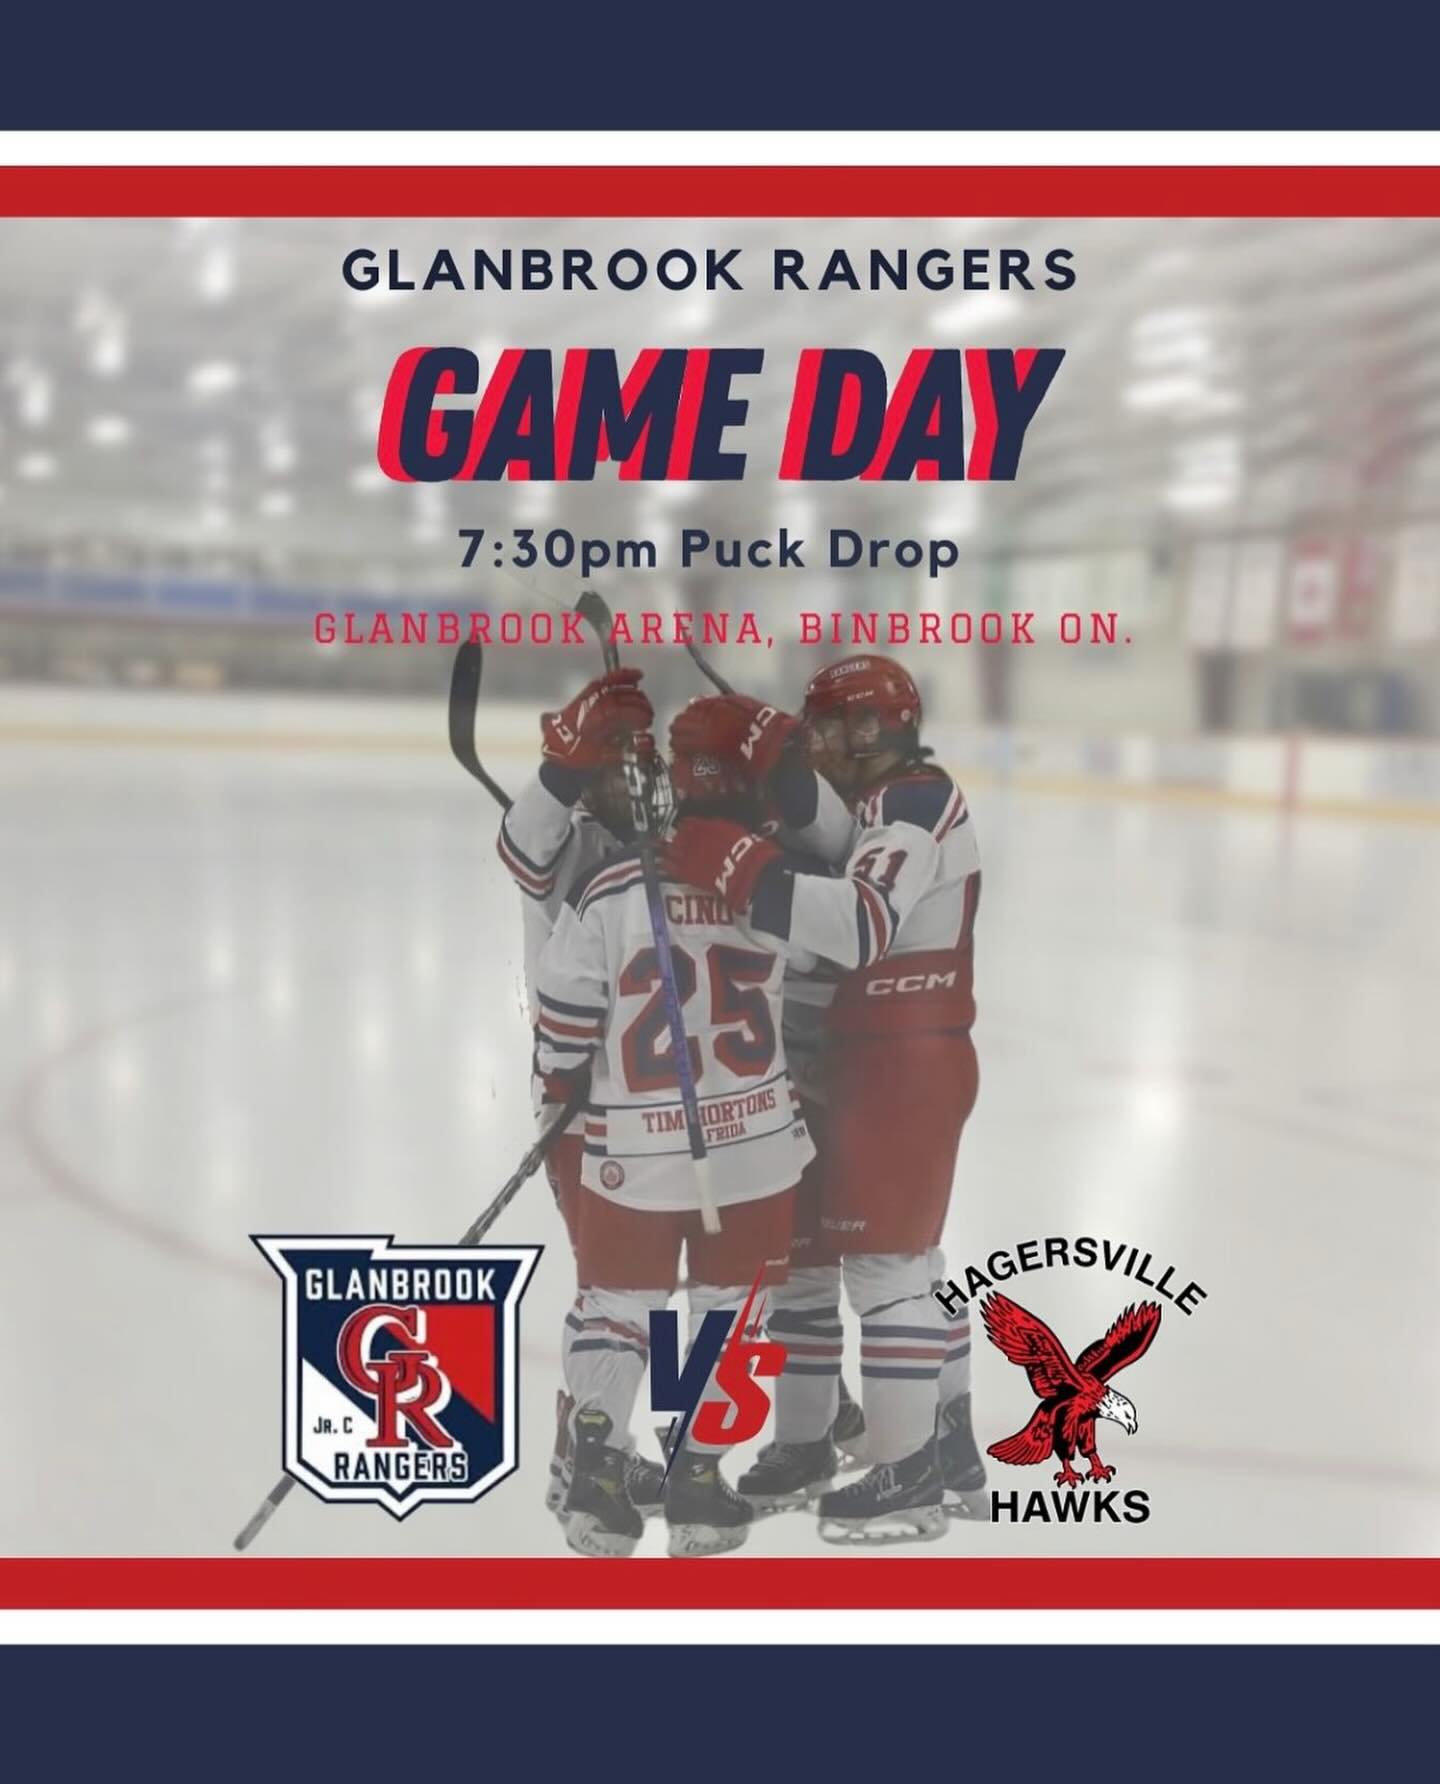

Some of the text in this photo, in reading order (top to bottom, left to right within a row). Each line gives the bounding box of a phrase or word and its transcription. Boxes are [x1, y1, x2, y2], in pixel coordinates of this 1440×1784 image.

[866, 971, 957, 996] CCM
[619, 944, 778, 1094] 25
[642, 1109, 686, 1134] TIM
[706, 1121, 747, 1143] FRIDA
